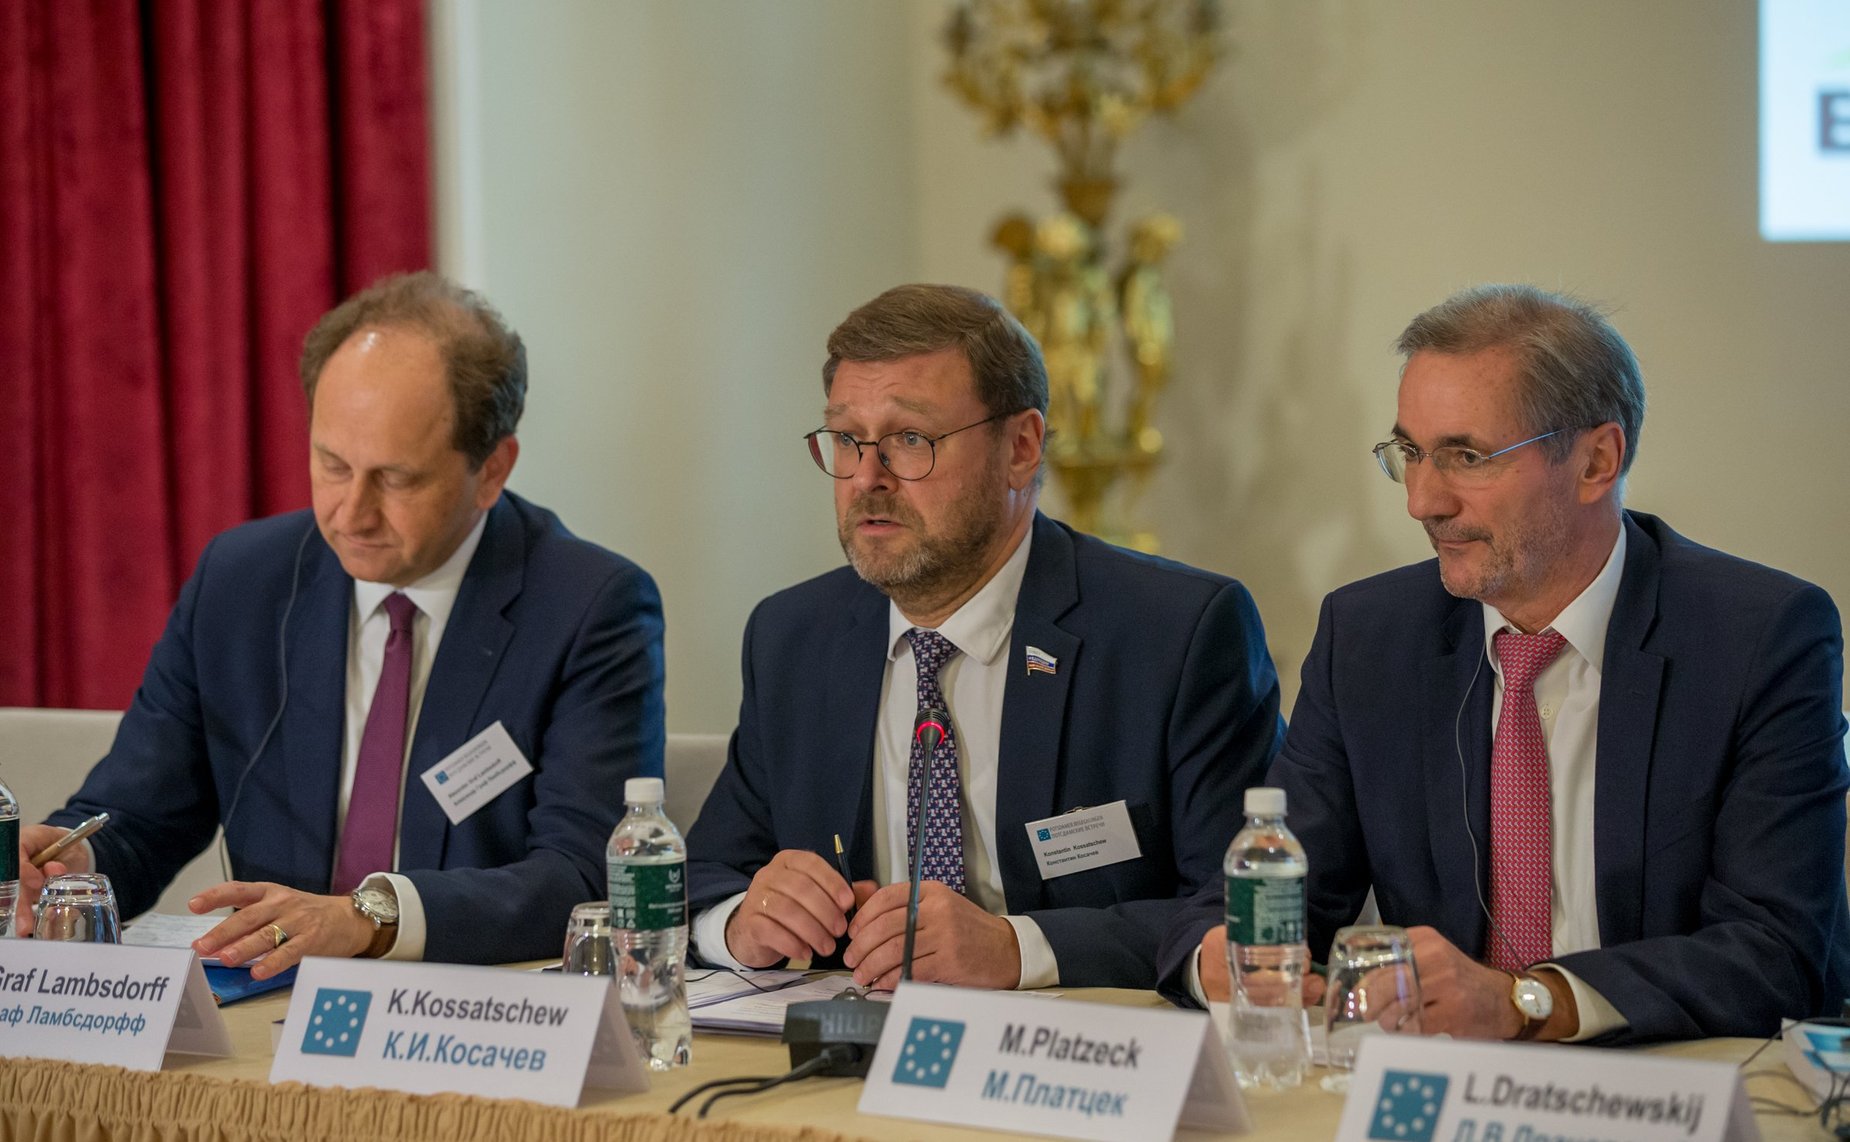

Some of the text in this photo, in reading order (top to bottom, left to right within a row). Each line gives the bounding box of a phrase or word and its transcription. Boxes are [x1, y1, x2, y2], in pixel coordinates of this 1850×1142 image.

[1044, 839, 1107, 857] Konstantin Kossatschew
[37, 968, 170, 1002] Lambsdorff
[26, 1005, 146, 1037] Ламбсдорфф
[387, 987, 569, 1027] K.Kossatschew
[382, 1029, 547, 1072] К.И.Косачев
[998, 1023, 1143, 1069] M.Platzeck
[981, 1069, 1129, 1117] М.Платцек
[1463, 1073, 1706, 1136] L.Dratschewskij
